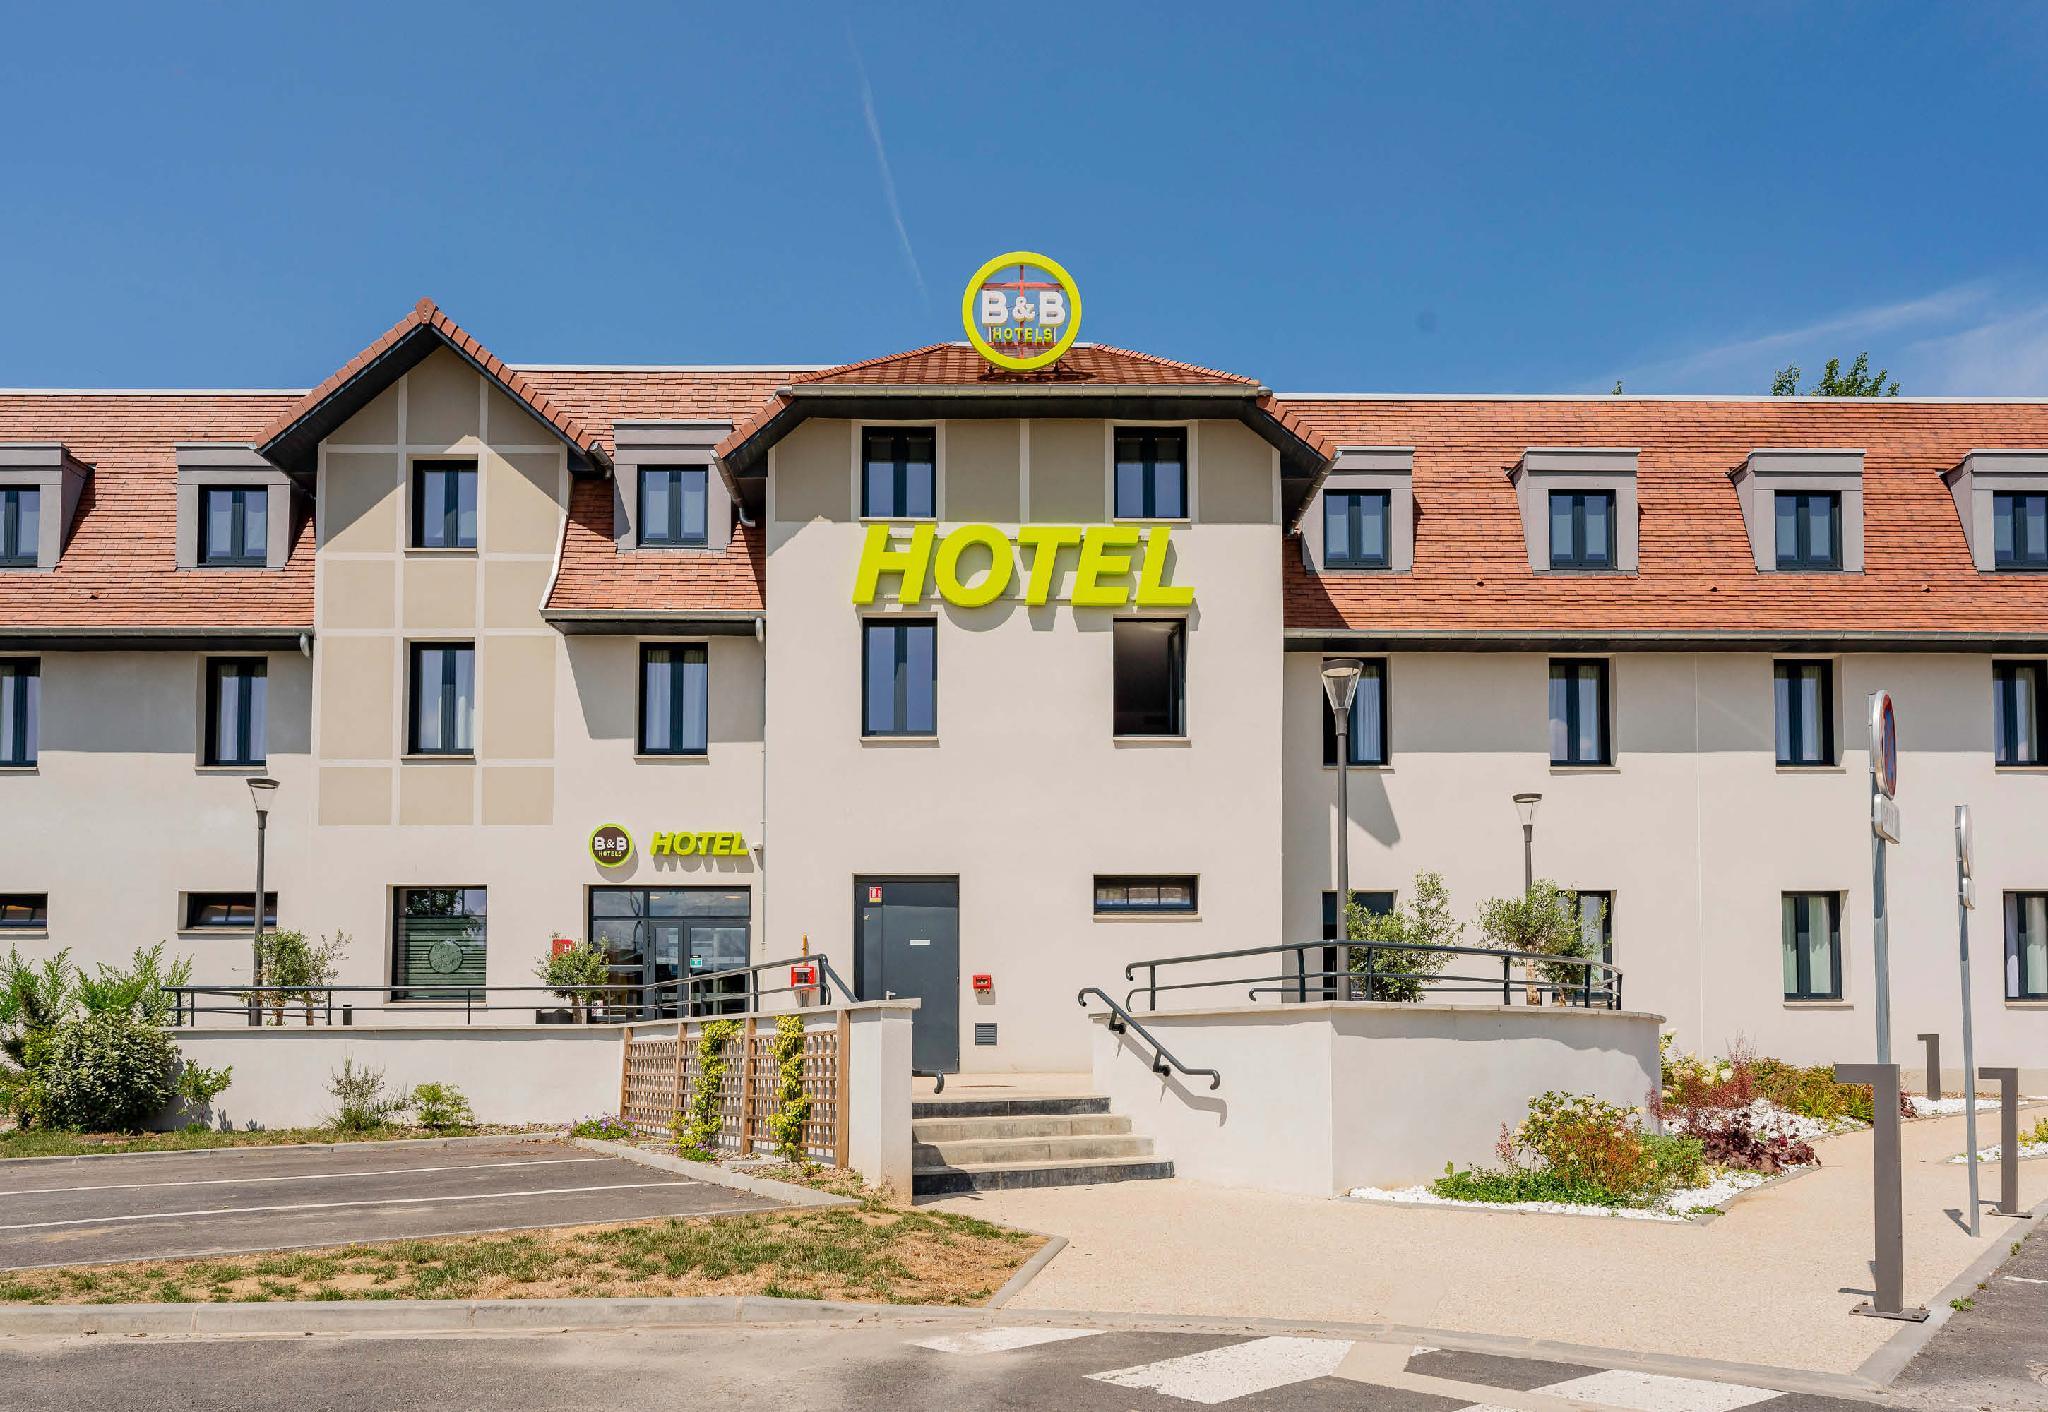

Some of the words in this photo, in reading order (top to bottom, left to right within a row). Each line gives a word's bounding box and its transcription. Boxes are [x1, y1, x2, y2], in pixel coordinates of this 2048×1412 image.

[982, 291, 1066, 327] B&B
[993, 328, 1053, 342] HOTELS
[852, 524, 1196, 607] HOTEL
[594, 836, 627, 850] B&B
[650, 832, 750, 857] HOTEL
